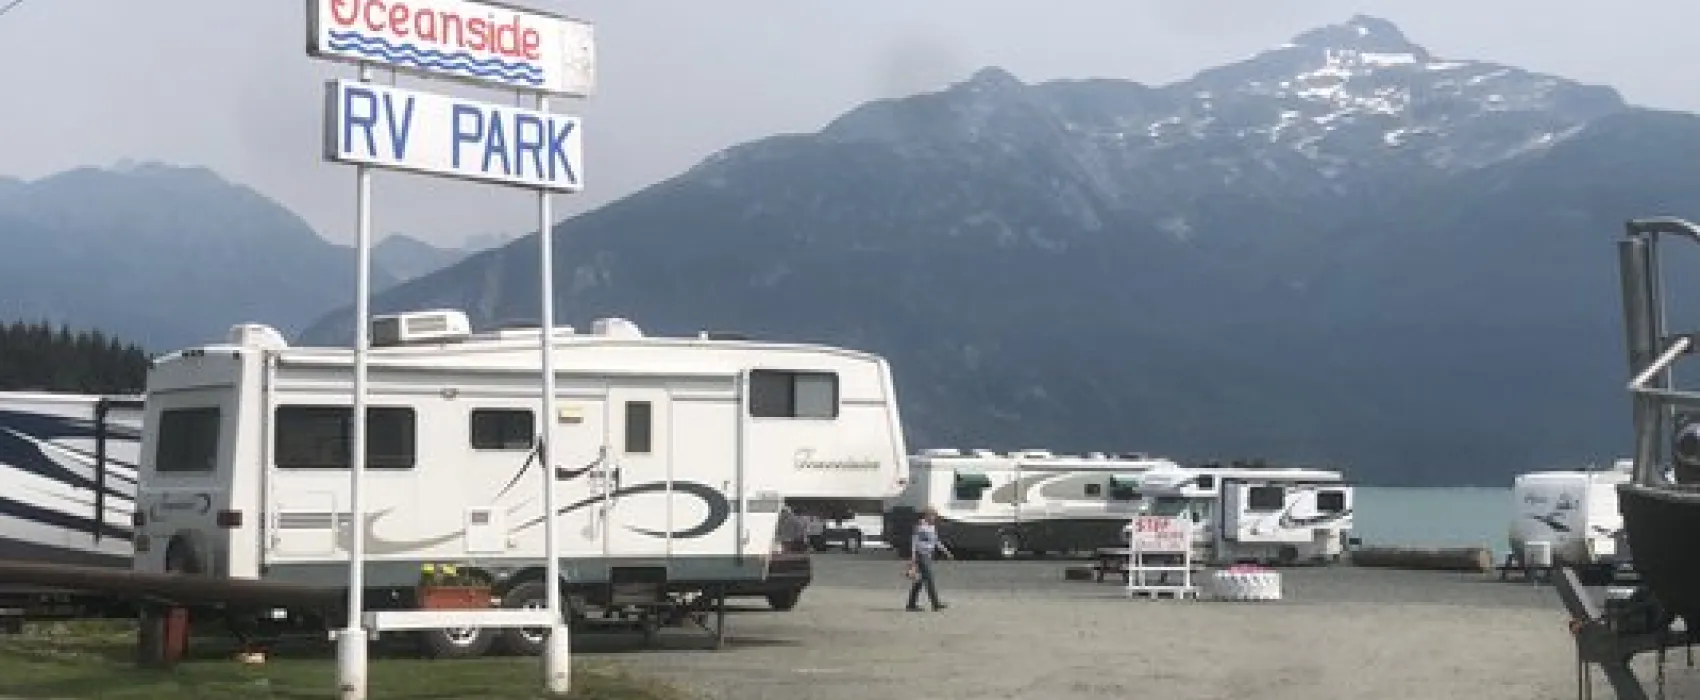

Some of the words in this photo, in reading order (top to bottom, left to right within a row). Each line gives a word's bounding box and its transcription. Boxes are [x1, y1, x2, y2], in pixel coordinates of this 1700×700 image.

[331, 0, 541, 60] Oceanside
[344, 87, 415, 160] RV
[452, 103, 576, 185] PARK
